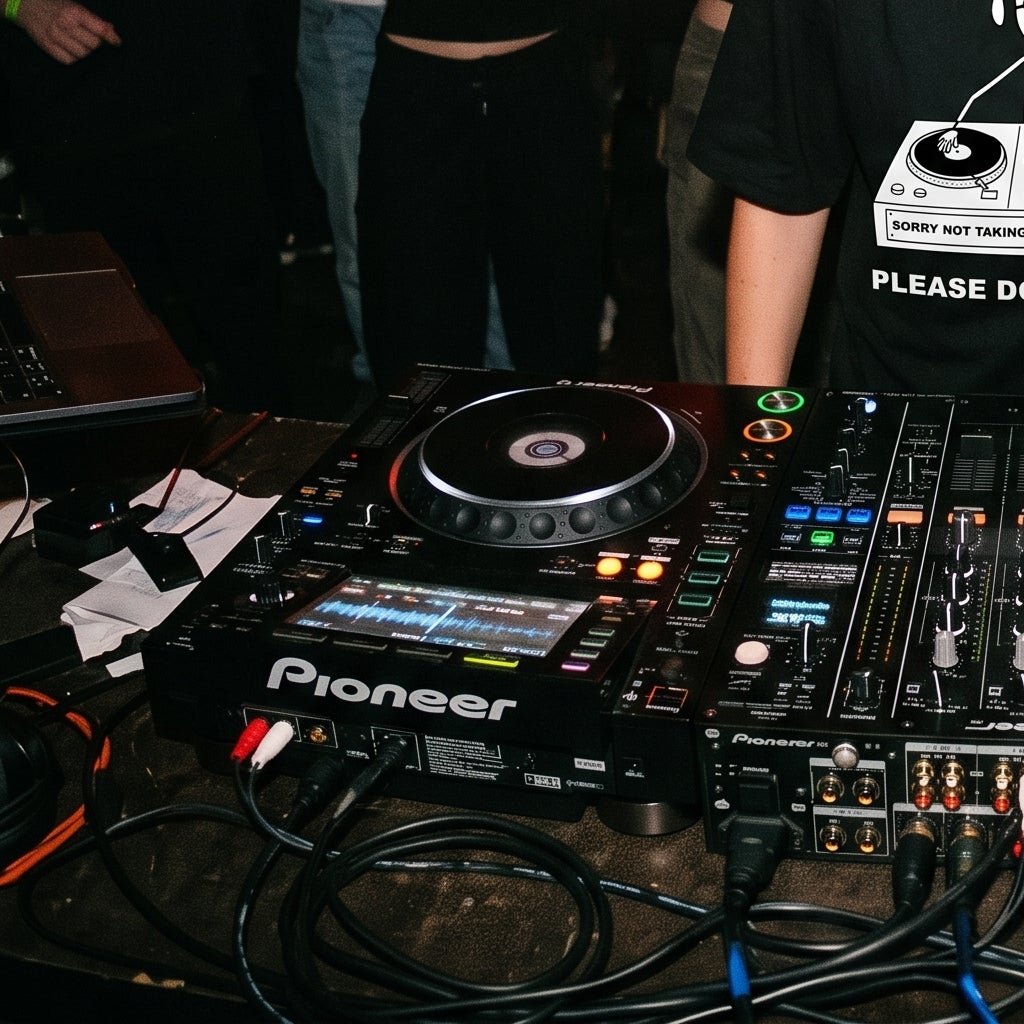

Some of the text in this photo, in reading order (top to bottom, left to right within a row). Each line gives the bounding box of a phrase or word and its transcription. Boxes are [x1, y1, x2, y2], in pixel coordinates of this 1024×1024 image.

[892, 220, 938, 234] SORRY
[942, 224, 972, 236] NOT
[872, 268, 987, 300] PLEASE
[266, 656, 518, 722] Pioneer
